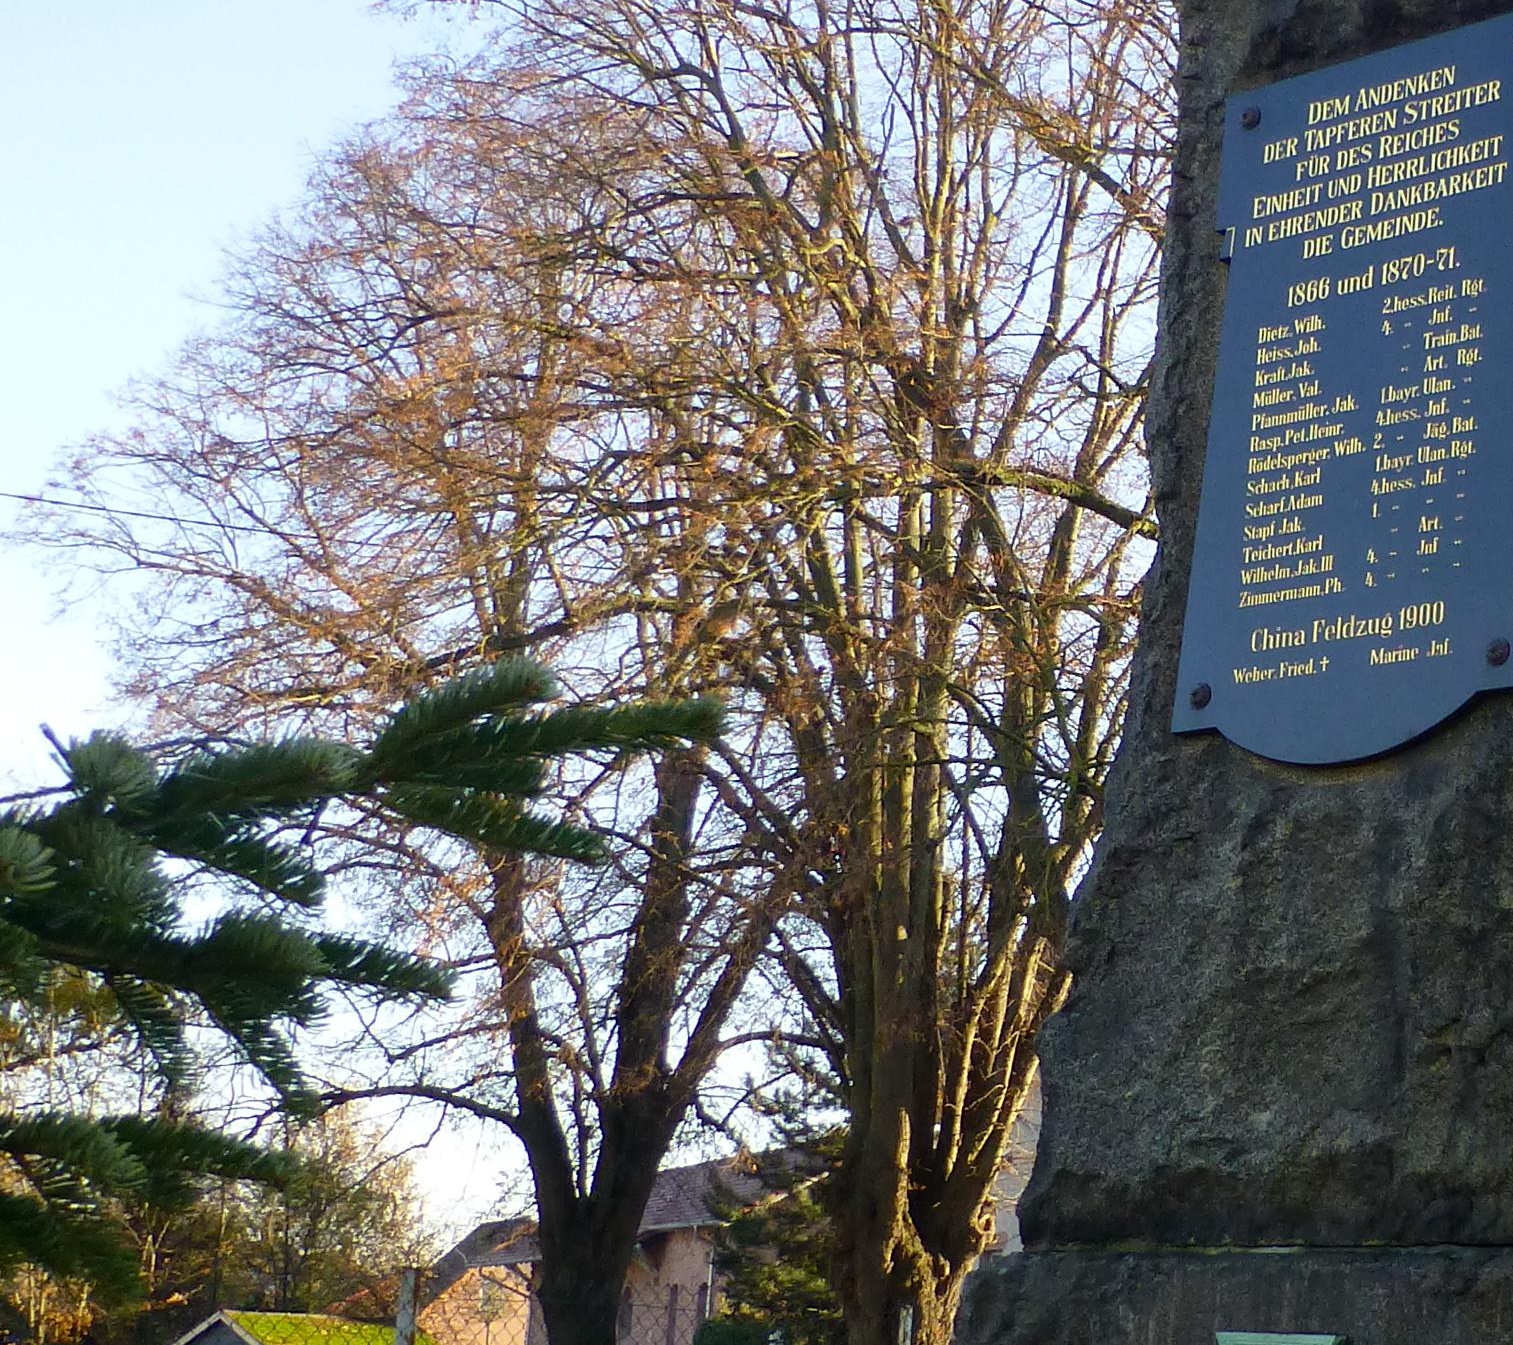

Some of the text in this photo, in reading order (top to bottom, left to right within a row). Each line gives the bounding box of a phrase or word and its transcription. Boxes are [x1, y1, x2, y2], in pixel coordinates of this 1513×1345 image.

[1264, 80, 1500, 164] DER TAPFEREN STREITER
[1308, 66, 1455, 125] DEM ANDENKEN
[1253, 136, 1503, 219] EINHEIT UND HERRLICHKEIT
[1296, 119, 1460, 181] FÜR DES REICHES
[1245, 163, 1508, 248] IN EHRENDER DANKBARKEIT
[1303, 208, 1443, 259] DIE GEMEINDE.
[1288, 277, 1330, 307] 1866
[1337, 265, 1374, 295] und
[1251, 601, 1444, 652] China Feldzug 1900
